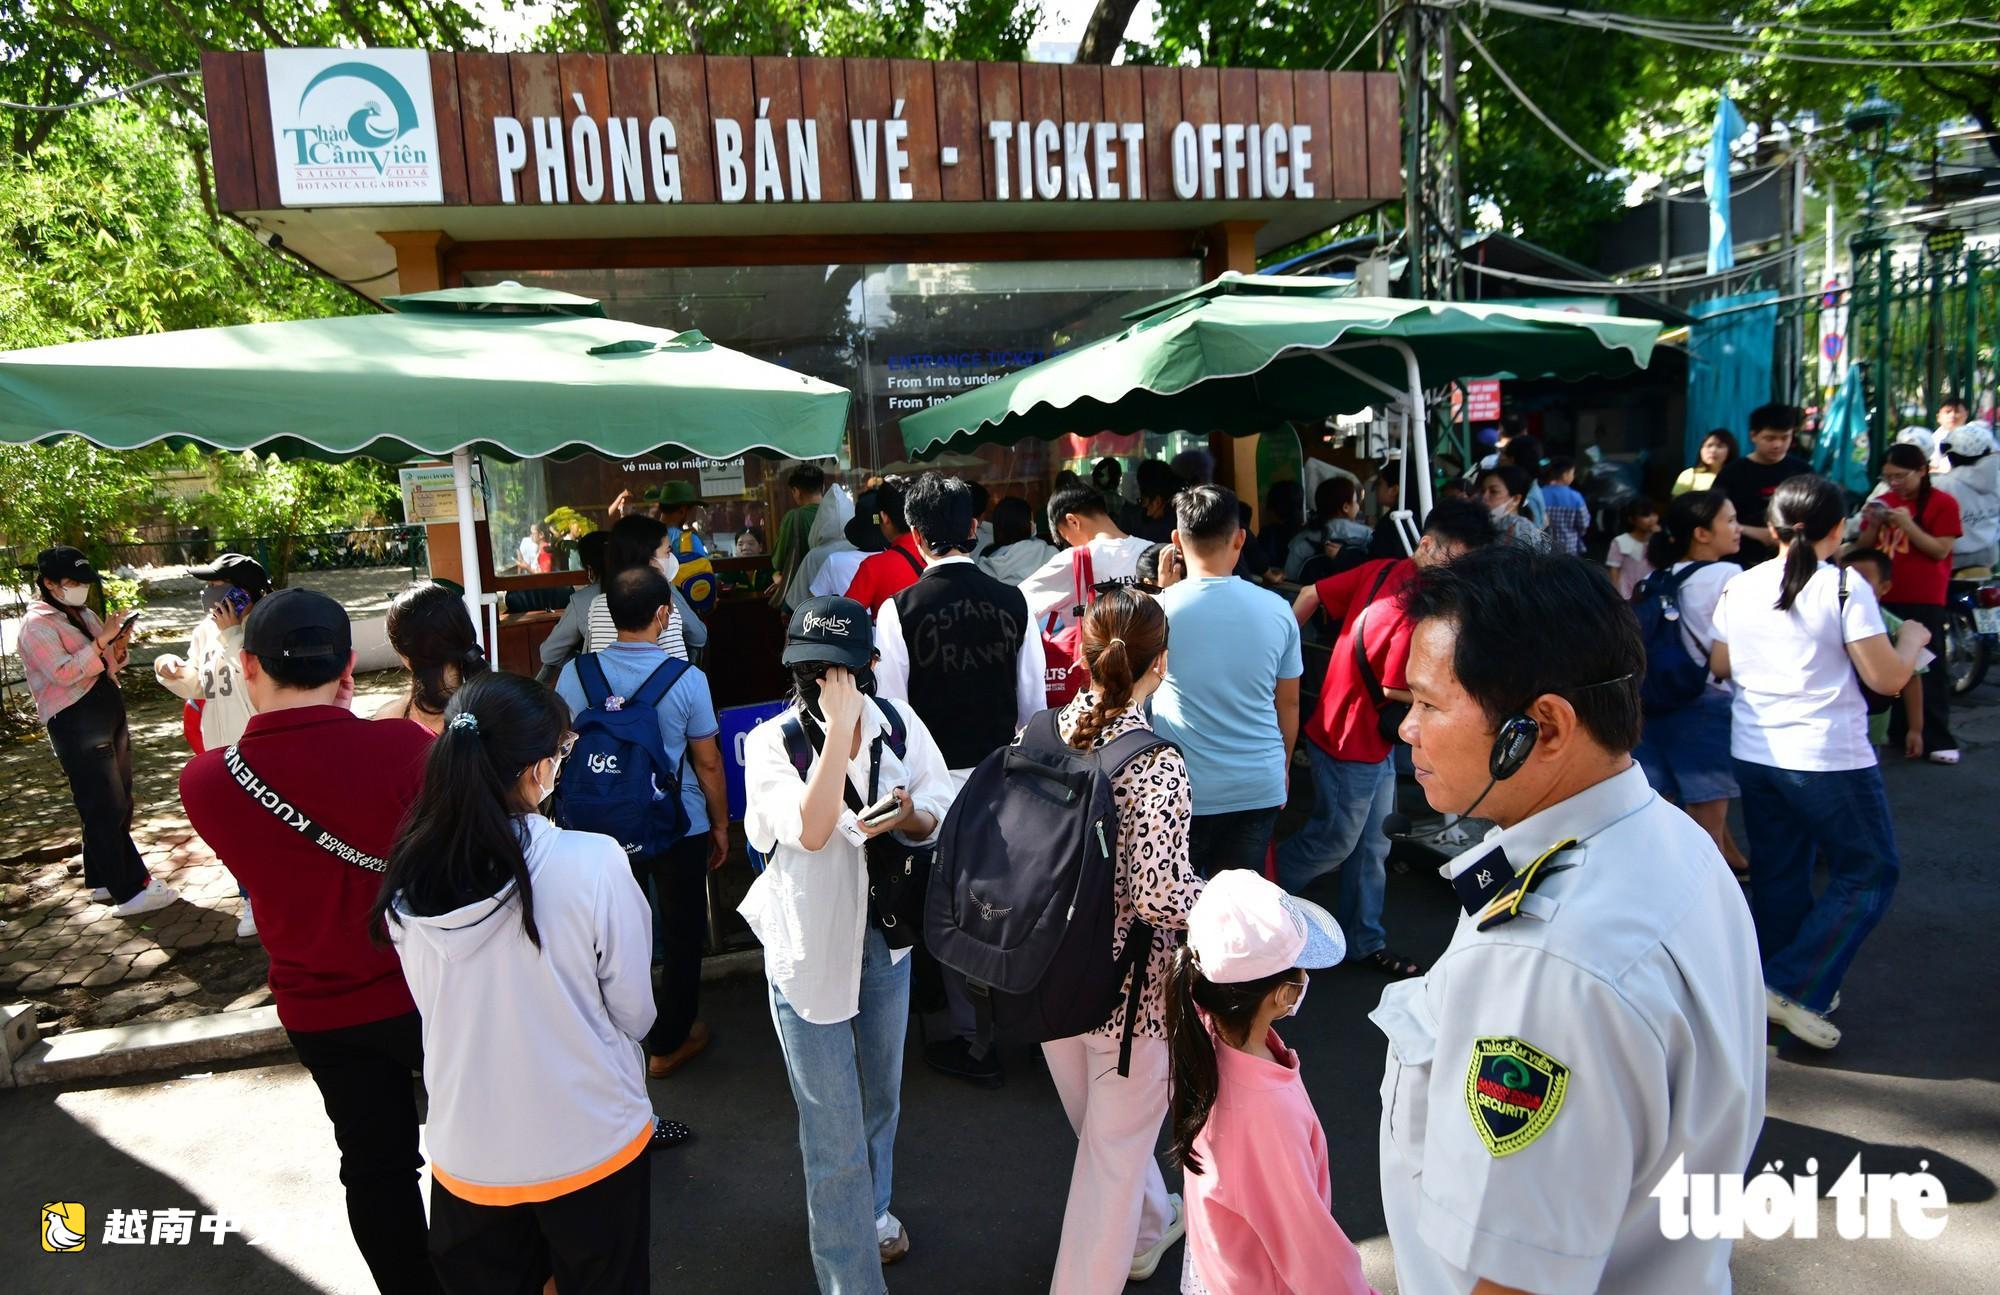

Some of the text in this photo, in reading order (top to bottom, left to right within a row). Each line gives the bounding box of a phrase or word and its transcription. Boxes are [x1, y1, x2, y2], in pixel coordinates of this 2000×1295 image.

[493, 92, 682, 204] PHÒNG
[715, 97, 821, 203] BÁN
[851, 98, 913, 201] VÉ
[988, 119, 1144, 201] TICKET
[1171, 121, 1315, 201] OFFICE
[296, 168, 359, 178] SAIGON
[887, 352, 983, 371] ENTRANCE
[888, 376, 922, 389] From
[925, 375, 945, 387] 1m
[948, 374, 960, 385] to
[964, 374, 1000, 385] under
[889, 397, 923, 409] From
[638, 463, 662, 471] mua
[204, 665, 233, 699] 23
[1044, 668, 1067, 681] LTS
[1478, 1092, 1537, 1120] SECURITY
